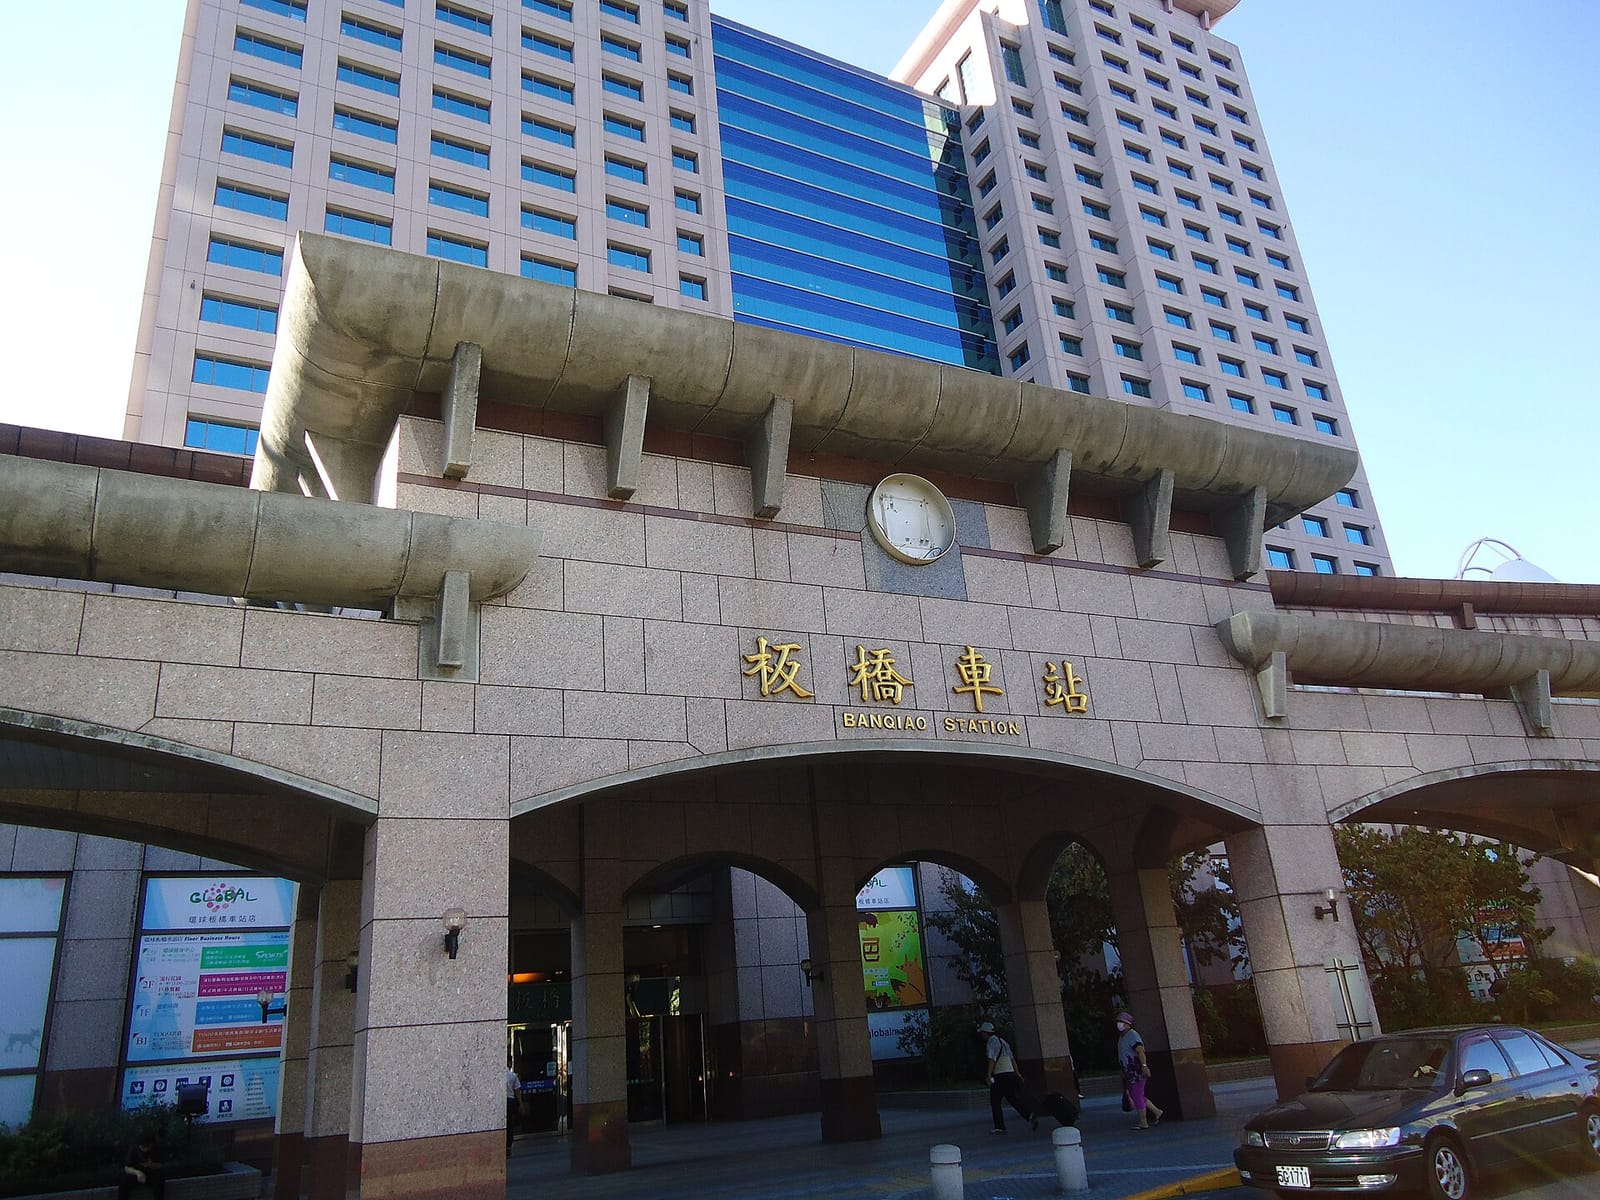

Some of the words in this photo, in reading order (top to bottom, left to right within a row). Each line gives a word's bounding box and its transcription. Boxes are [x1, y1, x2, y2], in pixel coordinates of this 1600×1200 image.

[742, 636, 1088, 713] 板橋車站
[843, 713, 928, 732] BANQIAO
[944, 718, 1021, 736] STATION
[189, 888, 258, 904] GLOBAL
[188, 915, 257, 925] 環球板橋車站店
[143, 980, 155, 989] 2F
